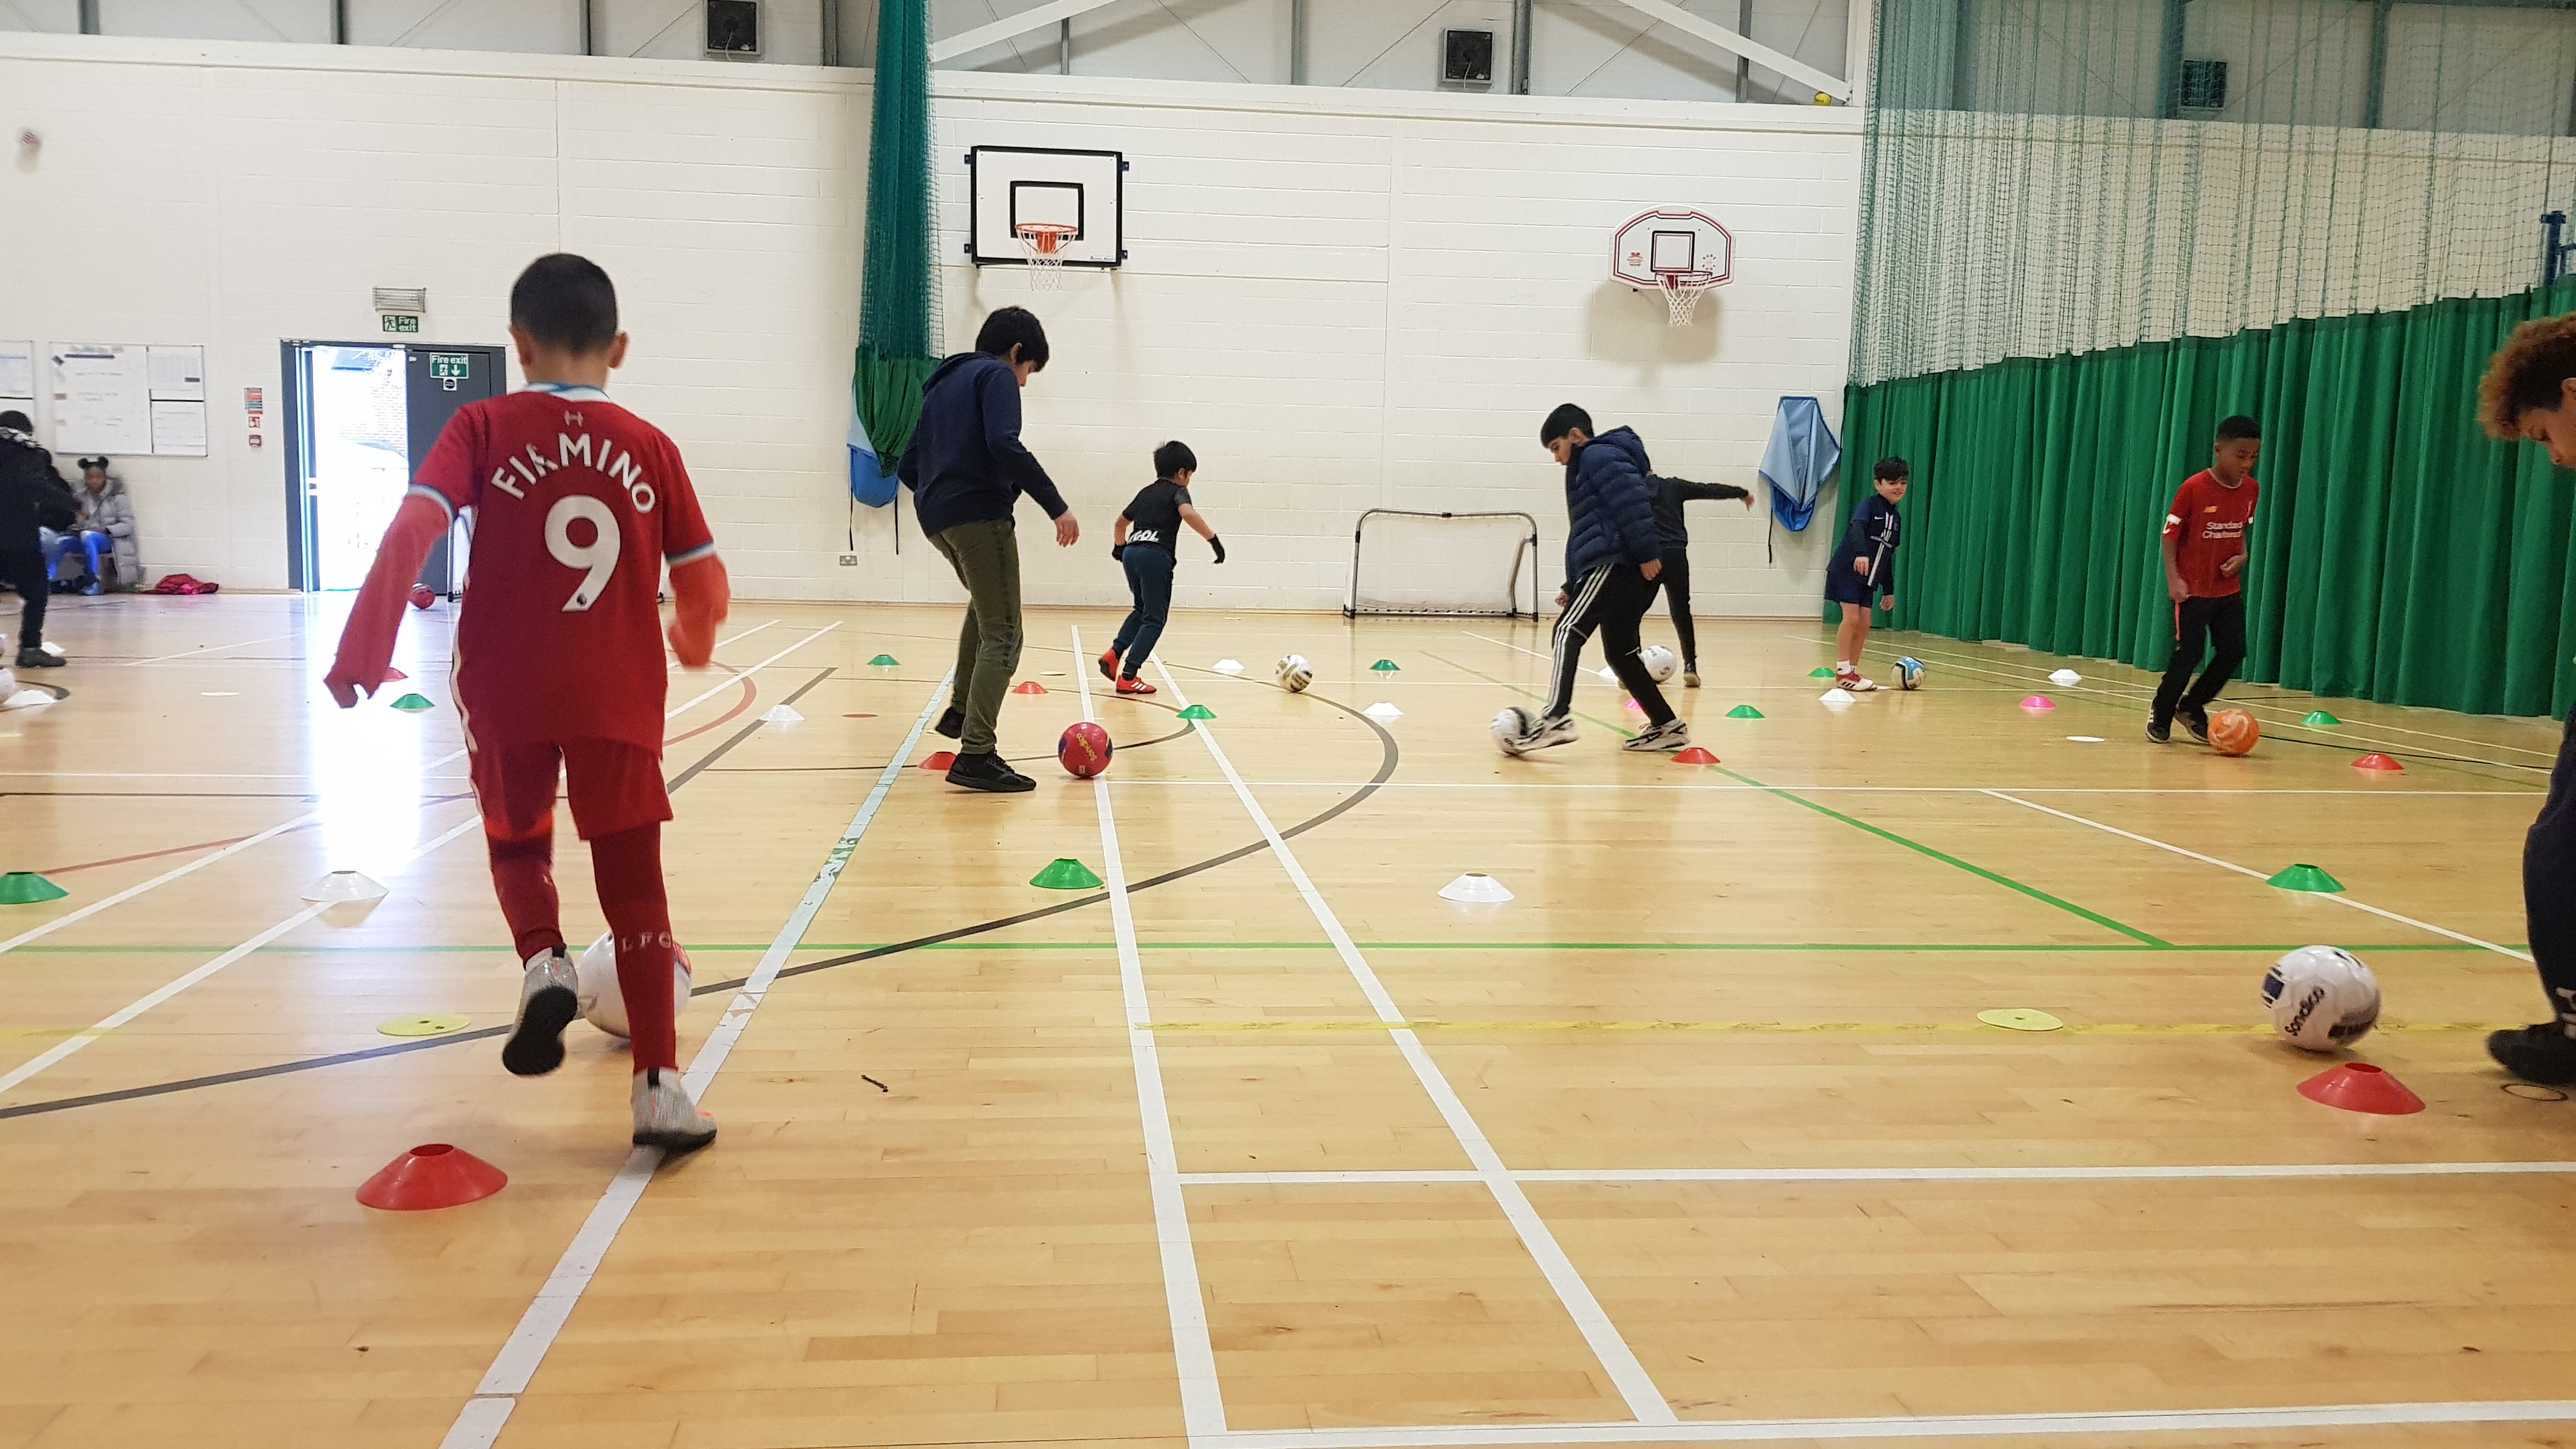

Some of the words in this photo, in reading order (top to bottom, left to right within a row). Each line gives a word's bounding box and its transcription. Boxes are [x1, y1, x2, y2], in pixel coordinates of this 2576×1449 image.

[399, 316, 416, 325] Fire
[431, 355, 449, 364] Fire
[450, 356, 466, 364] exit
[491, 433, 656, 514] FIRMINO
[544, 494, 622, 612] 9
